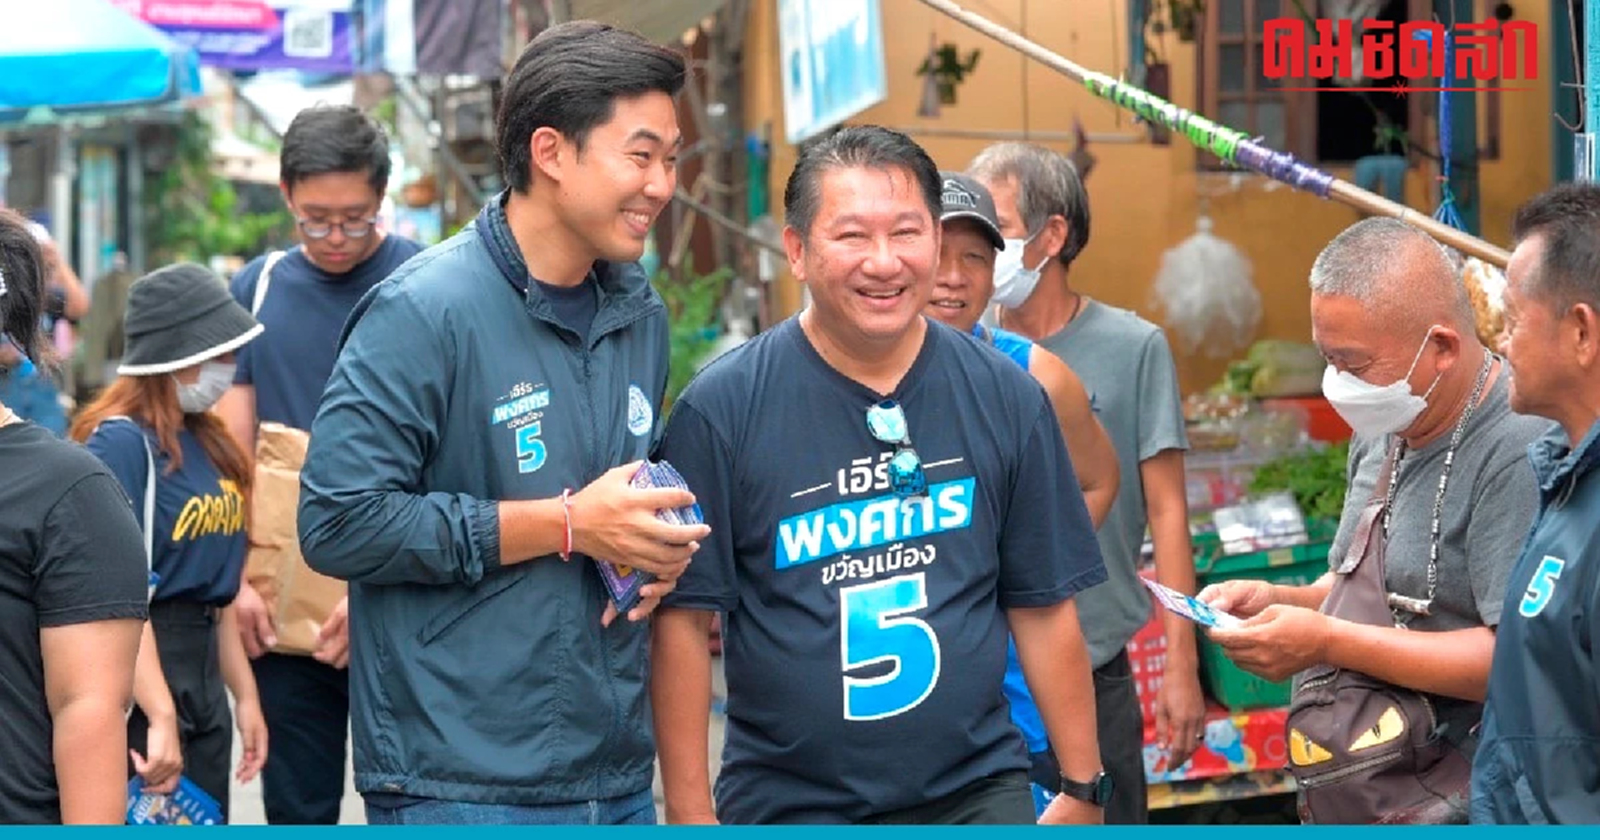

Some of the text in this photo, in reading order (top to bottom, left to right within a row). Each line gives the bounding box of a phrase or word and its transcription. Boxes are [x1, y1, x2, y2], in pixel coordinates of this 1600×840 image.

[515, 420, 547, 474] 5
[779, 484, 968, 563] พงศกร
[821, 542, 936, 585] ขวัญเมือง
[1518, 555, 1565, 618] 5
[839, 571, 941, 721] 5
